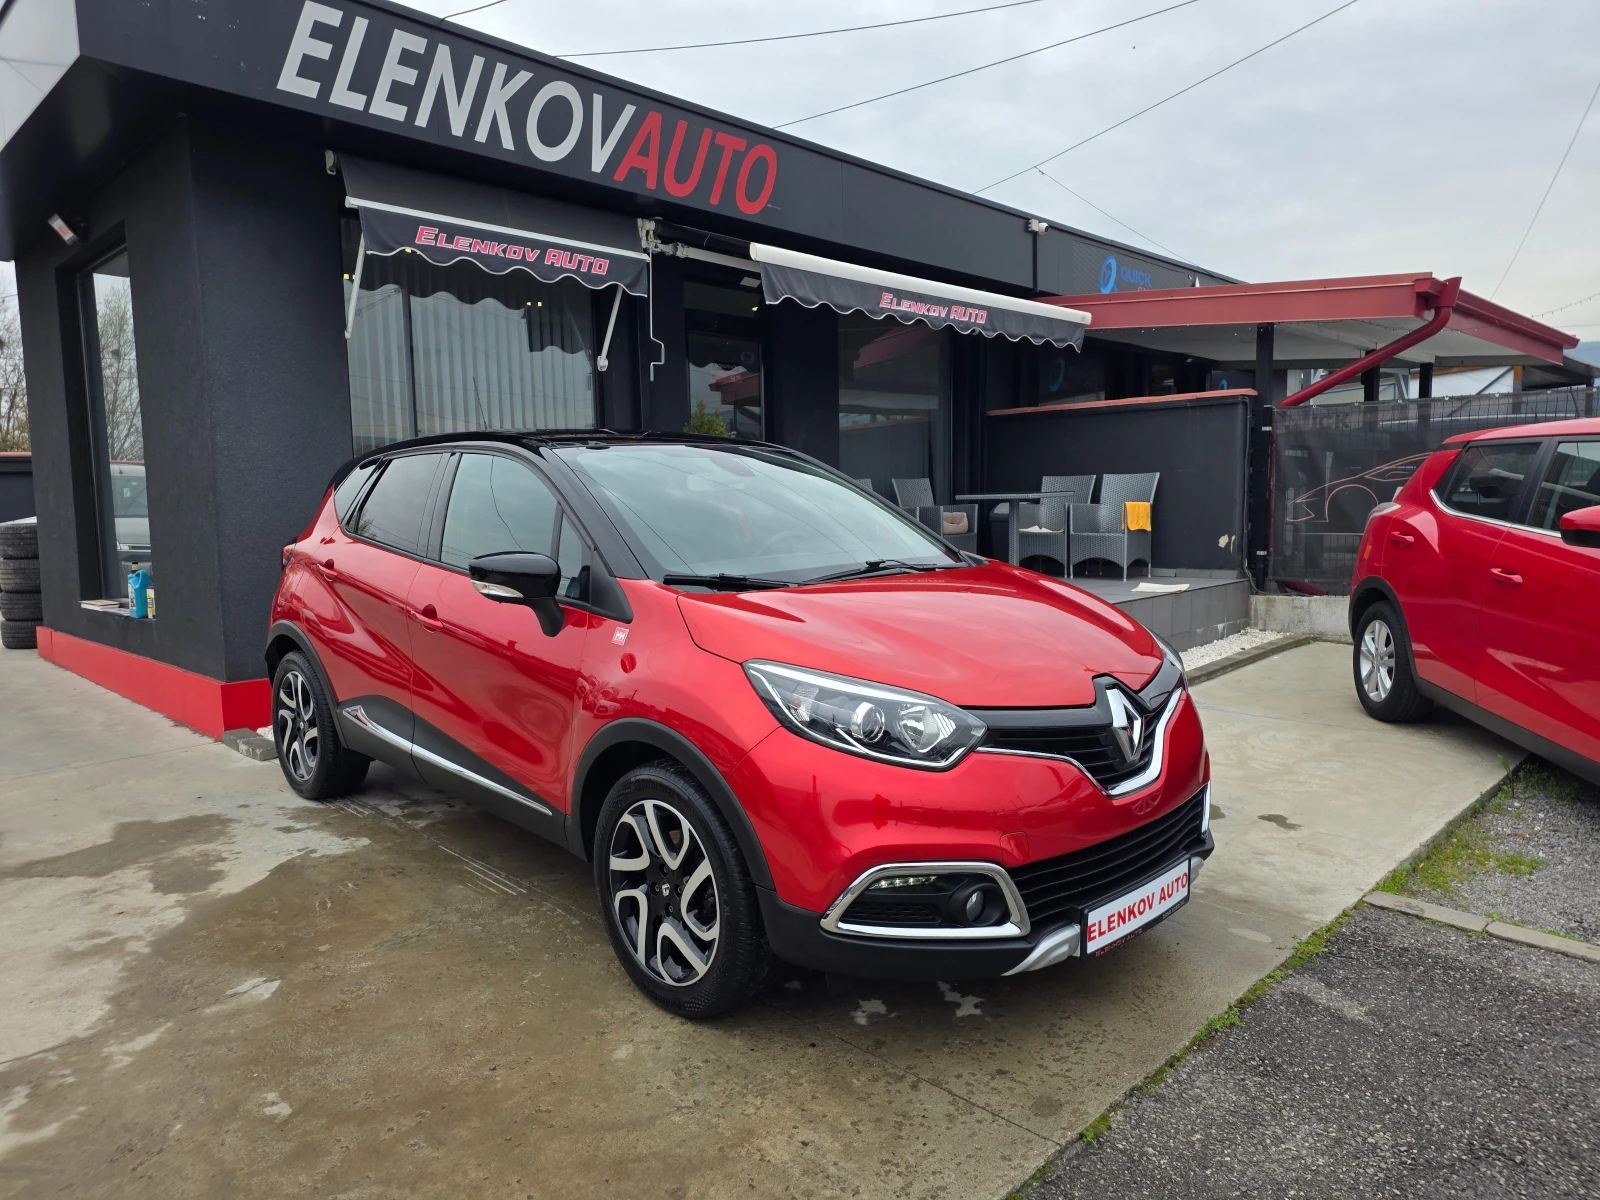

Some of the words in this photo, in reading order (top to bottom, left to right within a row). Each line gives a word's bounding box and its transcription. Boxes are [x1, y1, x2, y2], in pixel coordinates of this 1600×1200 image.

[415, 225, 540, 261] ELENKOV
[545, 248, 609, 275] AUTO
[1120, 266, 1152, 288] QUICK
[879, 292, 948, 317] ELENKOV
[950, 305, 988, 324] AUTO
[1087, 892, 1156, 943] ELENKOV
[1158, 872, 1188, 905] AUTO
